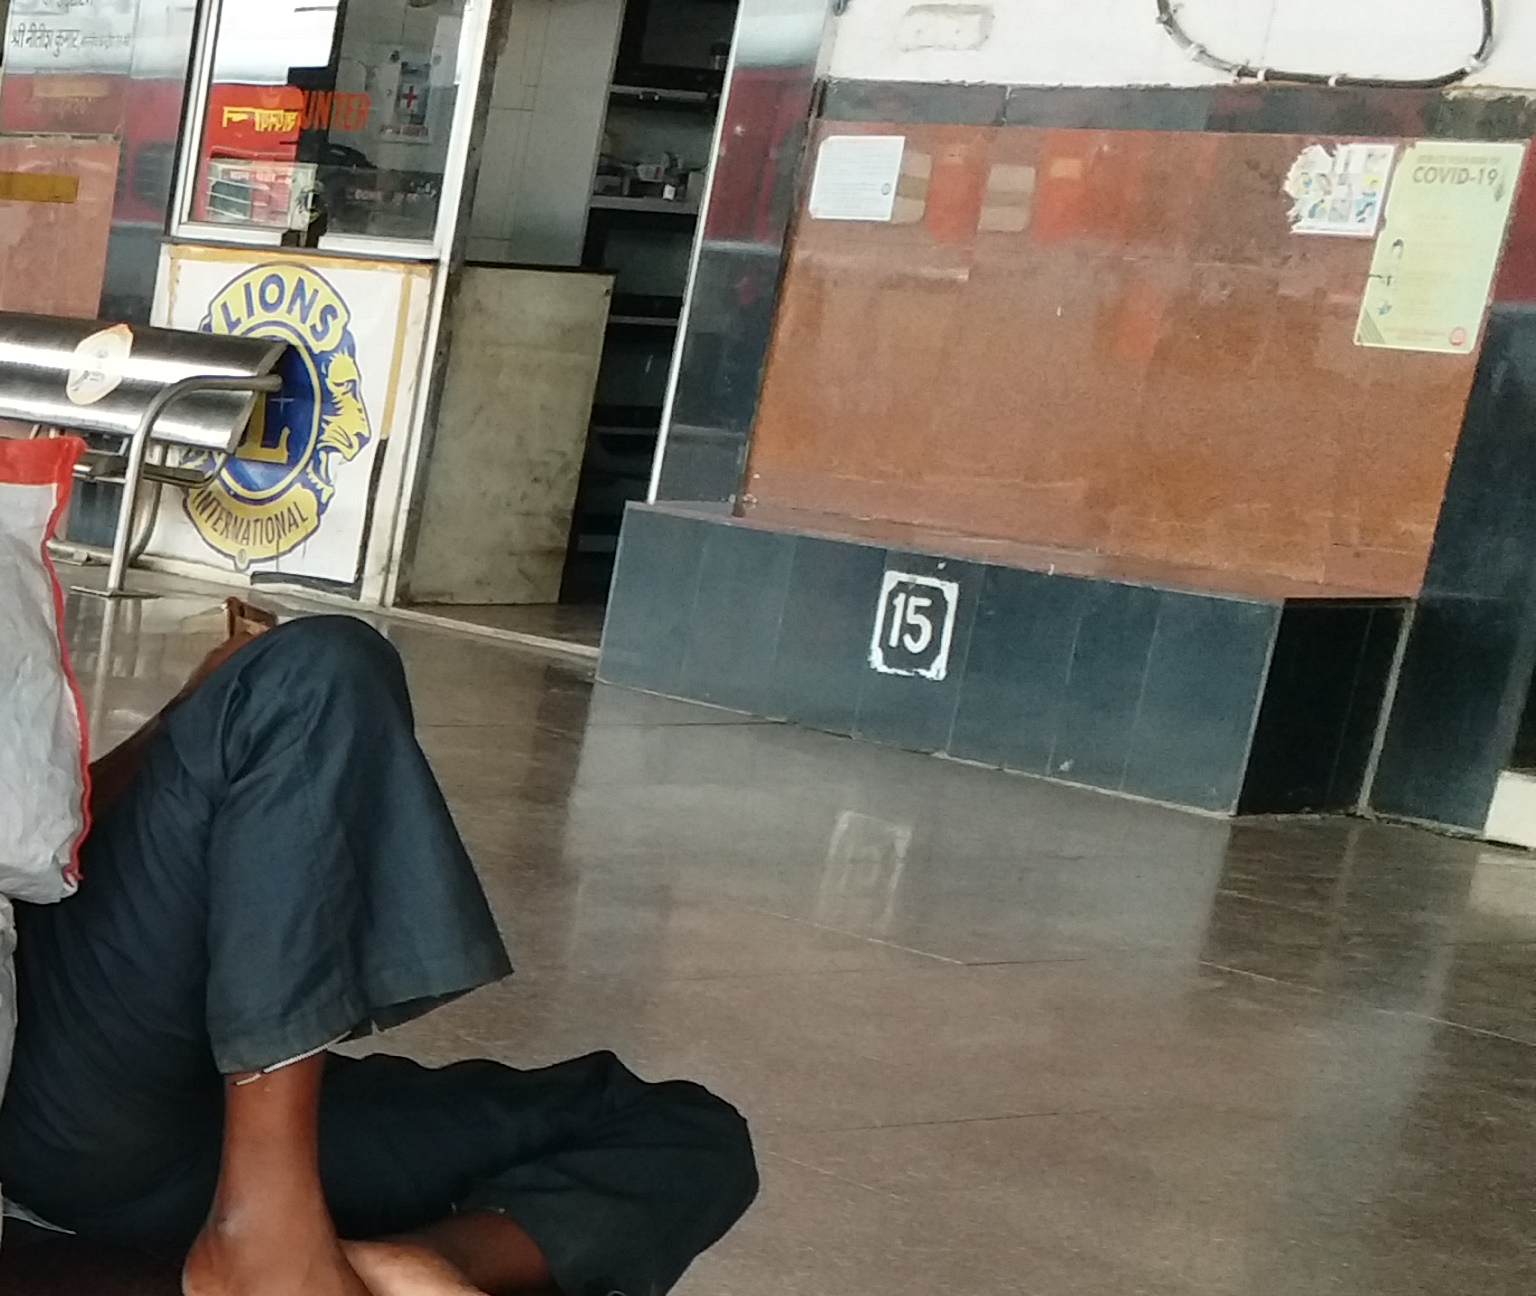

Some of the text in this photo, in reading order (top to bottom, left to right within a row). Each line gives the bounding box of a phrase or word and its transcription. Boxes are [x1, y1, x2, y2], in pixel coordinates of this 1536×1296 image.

[1413, 165, 1500, 187] COVID-19
[220, 273, 339, 342] LIONS
[194, 488, 310, 546] INTERNATIONAL
[889, 592, 933, 654] 15
